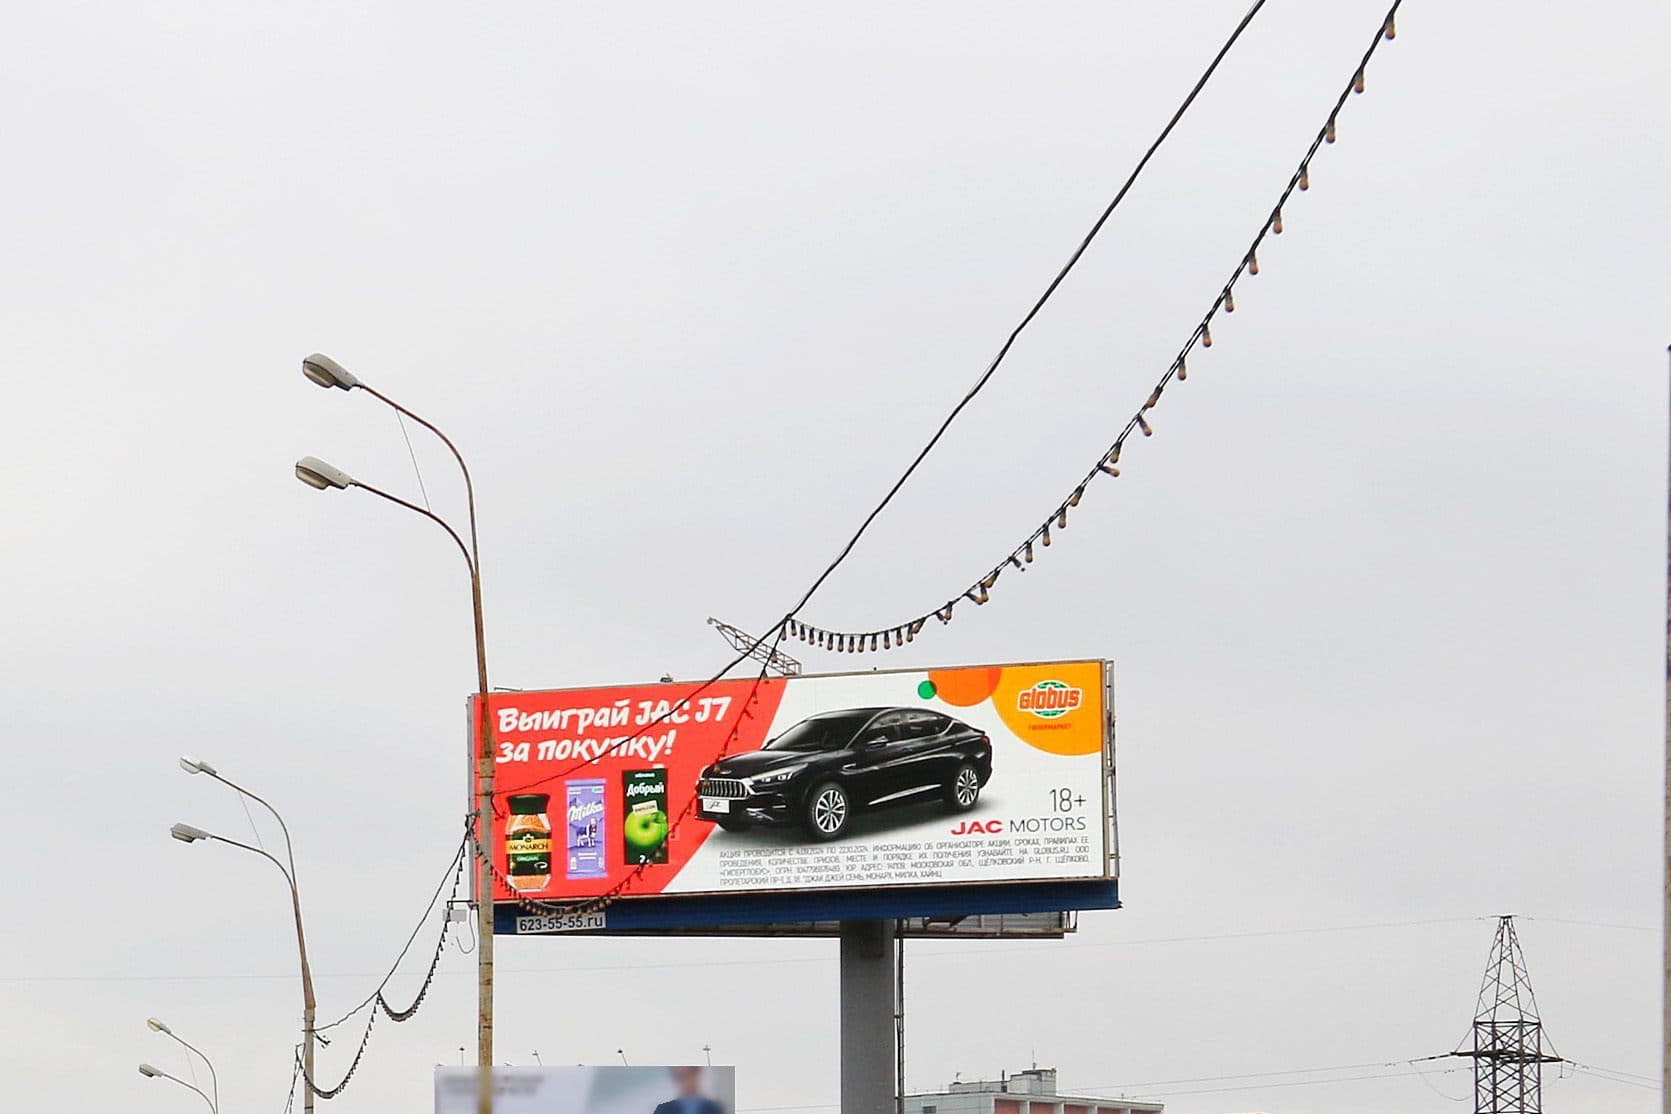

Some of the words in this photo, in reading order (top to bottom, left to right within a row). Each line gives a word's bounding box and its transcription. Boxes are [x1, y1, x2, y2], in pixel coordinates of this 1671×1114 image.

[497, 698, 630, 735] Выиграй
[635, 699, 689, 726] JAC
[695, 696, 732, 723] J7
[496, 741, 530, 764] за
[537, 729, 677, 764] покупку!
[626, 781, 665, 797] Добрый
[1049, 787, 1087, 813] 18+
[567, 801, 604, 822] Milka
[951, 820, 1003, 836] JAC
[1009, 816, 1087, 833] MOTORS
[509, 842, 549, 851] MONARCH
[519, 915, 604, 932] 623-55-55.ru
